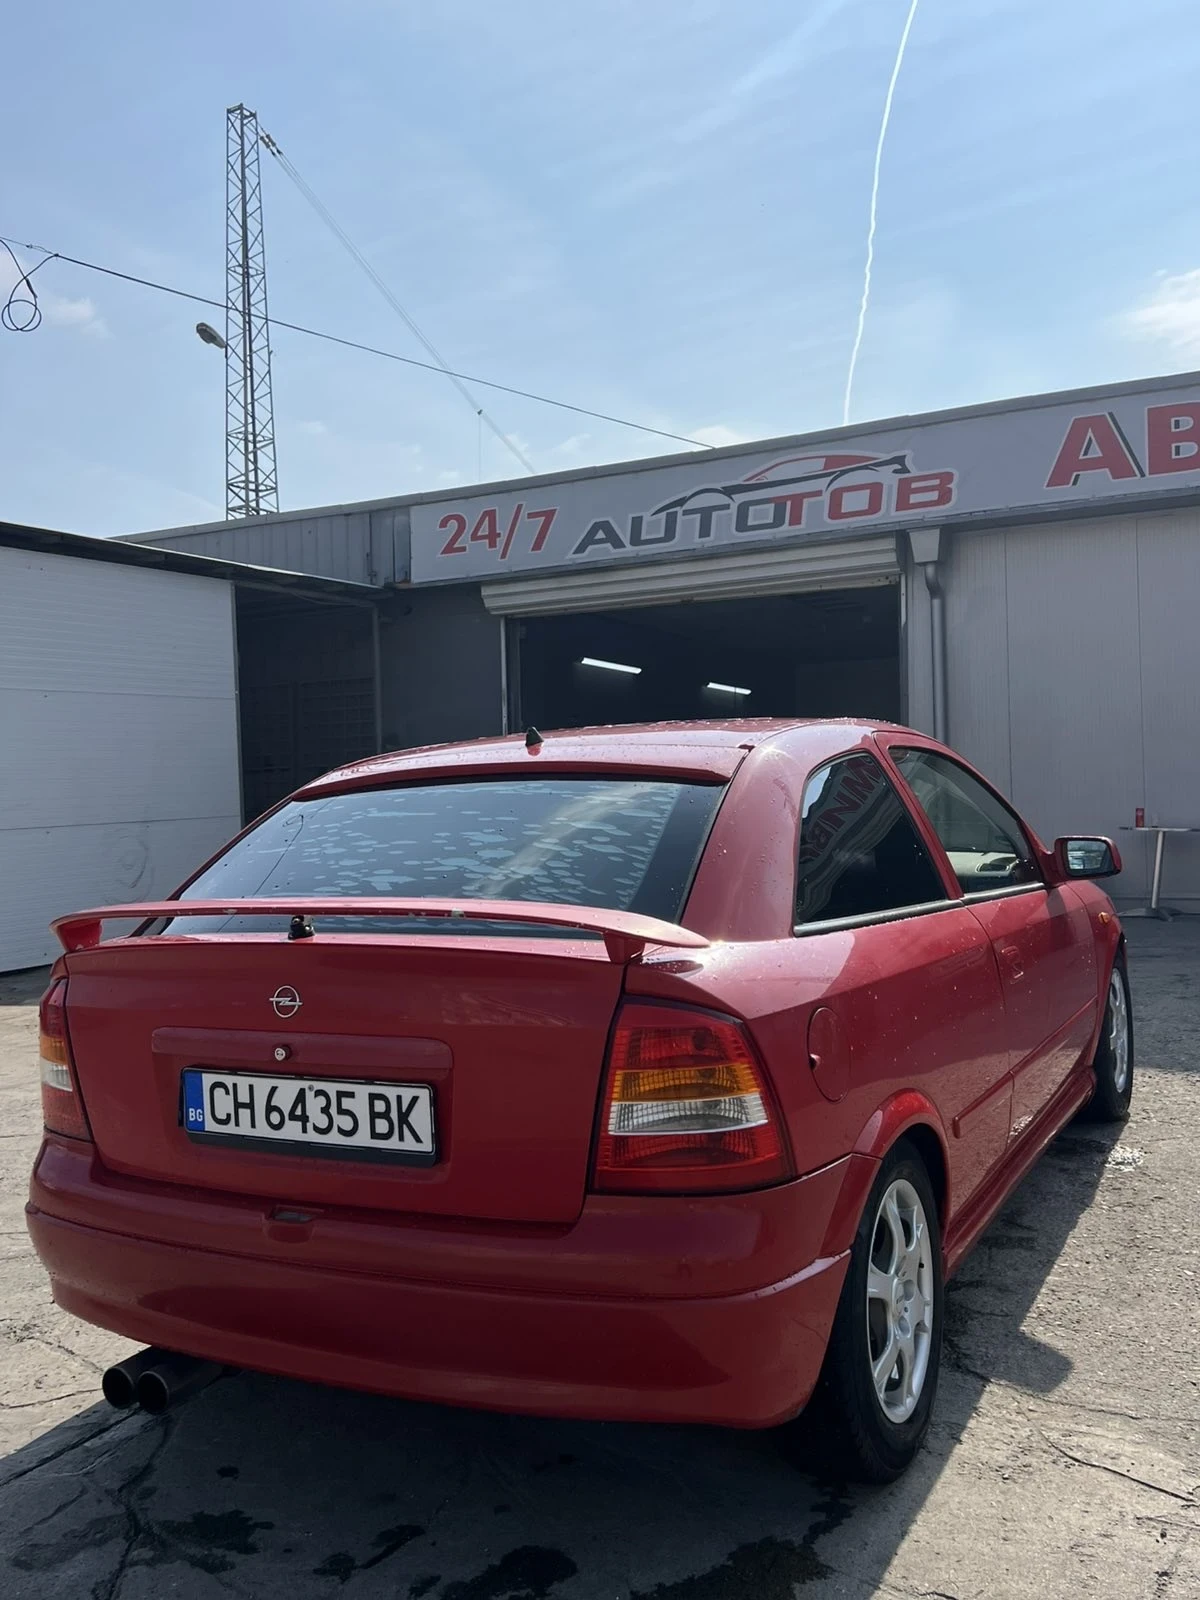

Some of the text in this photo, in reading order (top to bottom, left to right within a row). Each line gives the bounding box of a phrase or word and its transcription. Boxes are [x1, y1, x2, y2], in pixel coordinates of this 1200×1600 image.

[438, 471, 955, 560] 24/7 AUTOTOB
[188, 1107, 204, 1122] BG
[208, 1080, 424, 1144] CH 6435 BK
